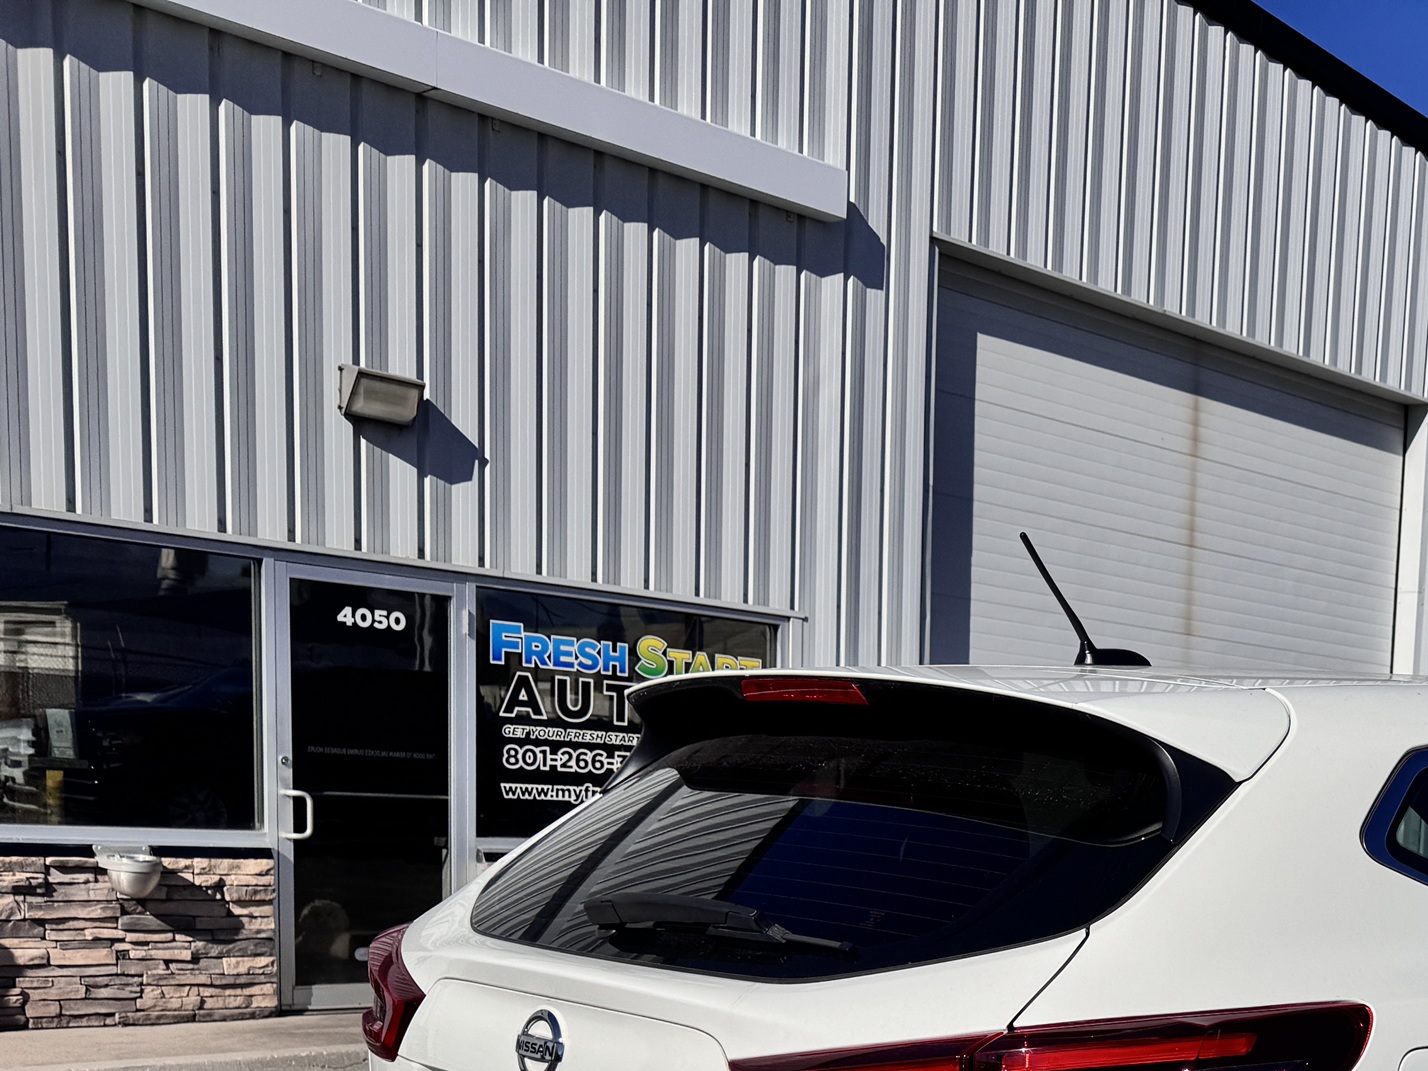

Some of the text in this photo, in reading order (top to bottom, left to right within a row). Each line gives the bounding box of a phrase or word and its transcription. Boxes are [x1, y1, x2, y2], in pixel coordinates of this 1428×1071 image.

[337, 606, 406, 631] 4050
[490, 619, 629, 677] FRESH
[499, 671, 638, 726] AUT
[502, 724, 529, 738] GET
[530, 726, 565, 740] YOUR
[565, 728, 605, 743] FRESH
[503, 744, 631, 774] 801-266-3
[500, 782, 601, 804] www.myfr
[519, 1040, 555, 1058] NISSAN
